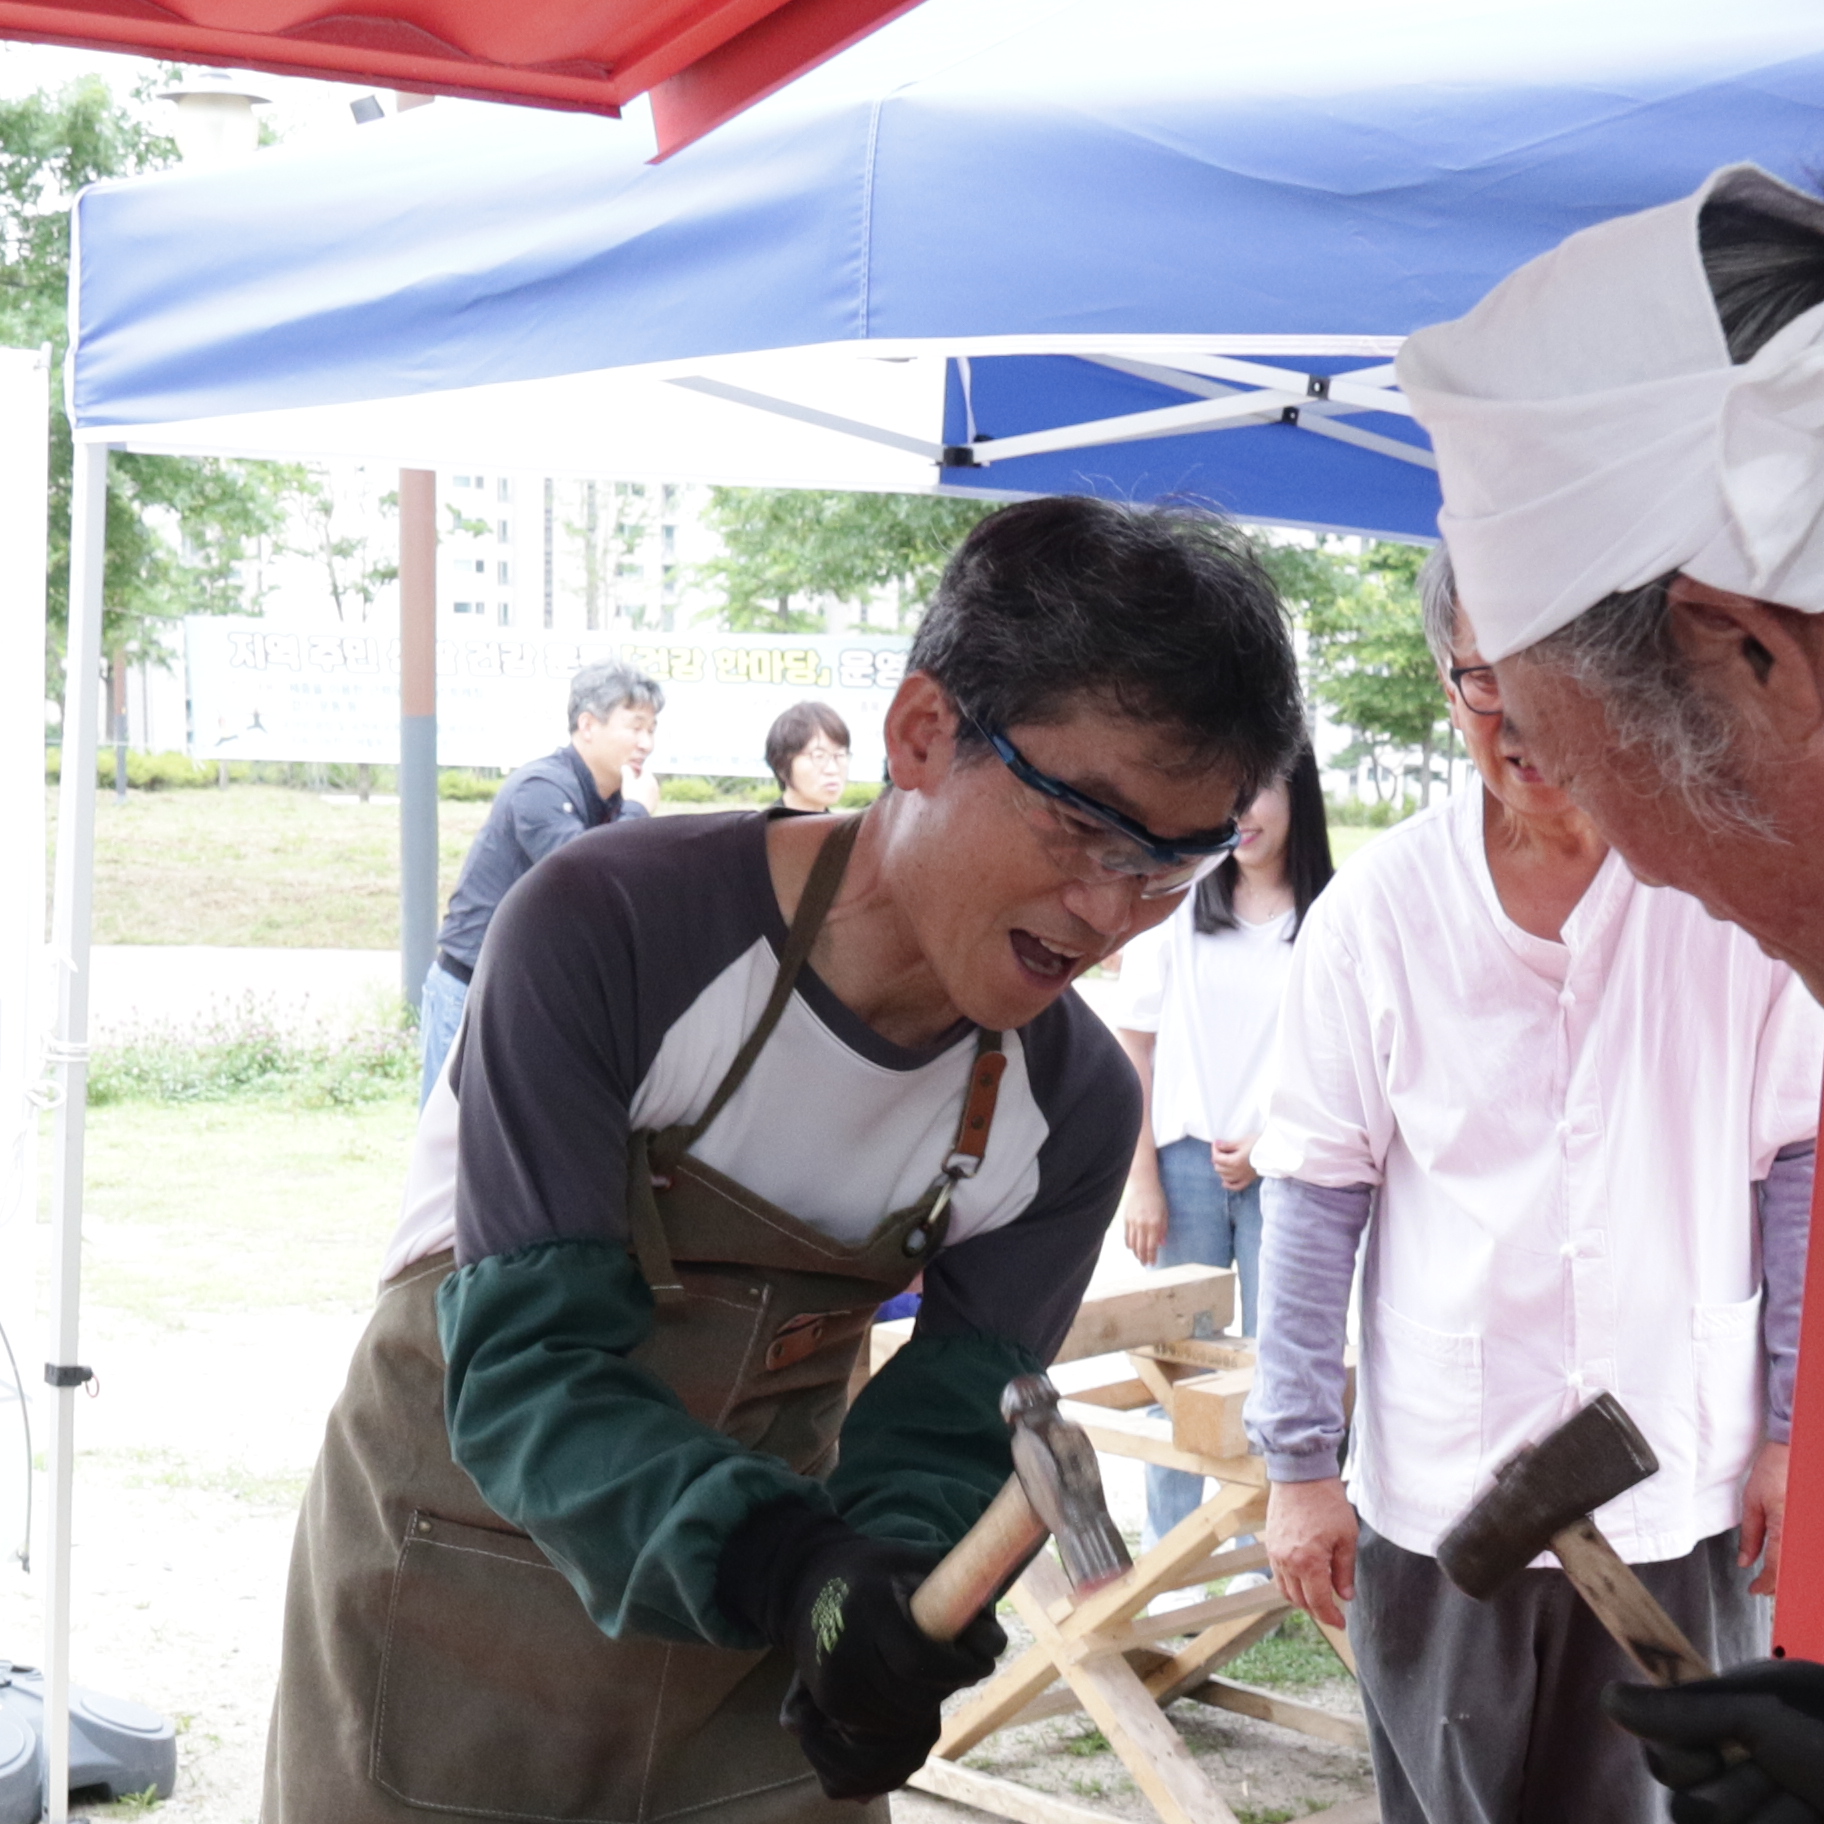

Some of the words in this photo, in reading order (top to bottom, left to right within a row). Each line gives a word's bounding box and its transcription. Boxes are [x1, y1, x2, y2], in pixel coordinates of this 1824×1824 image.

[227, 631, 302, 672] 지역
[307, 635, 381, 674] 주민
[465, 640, 537, 678] 건강
